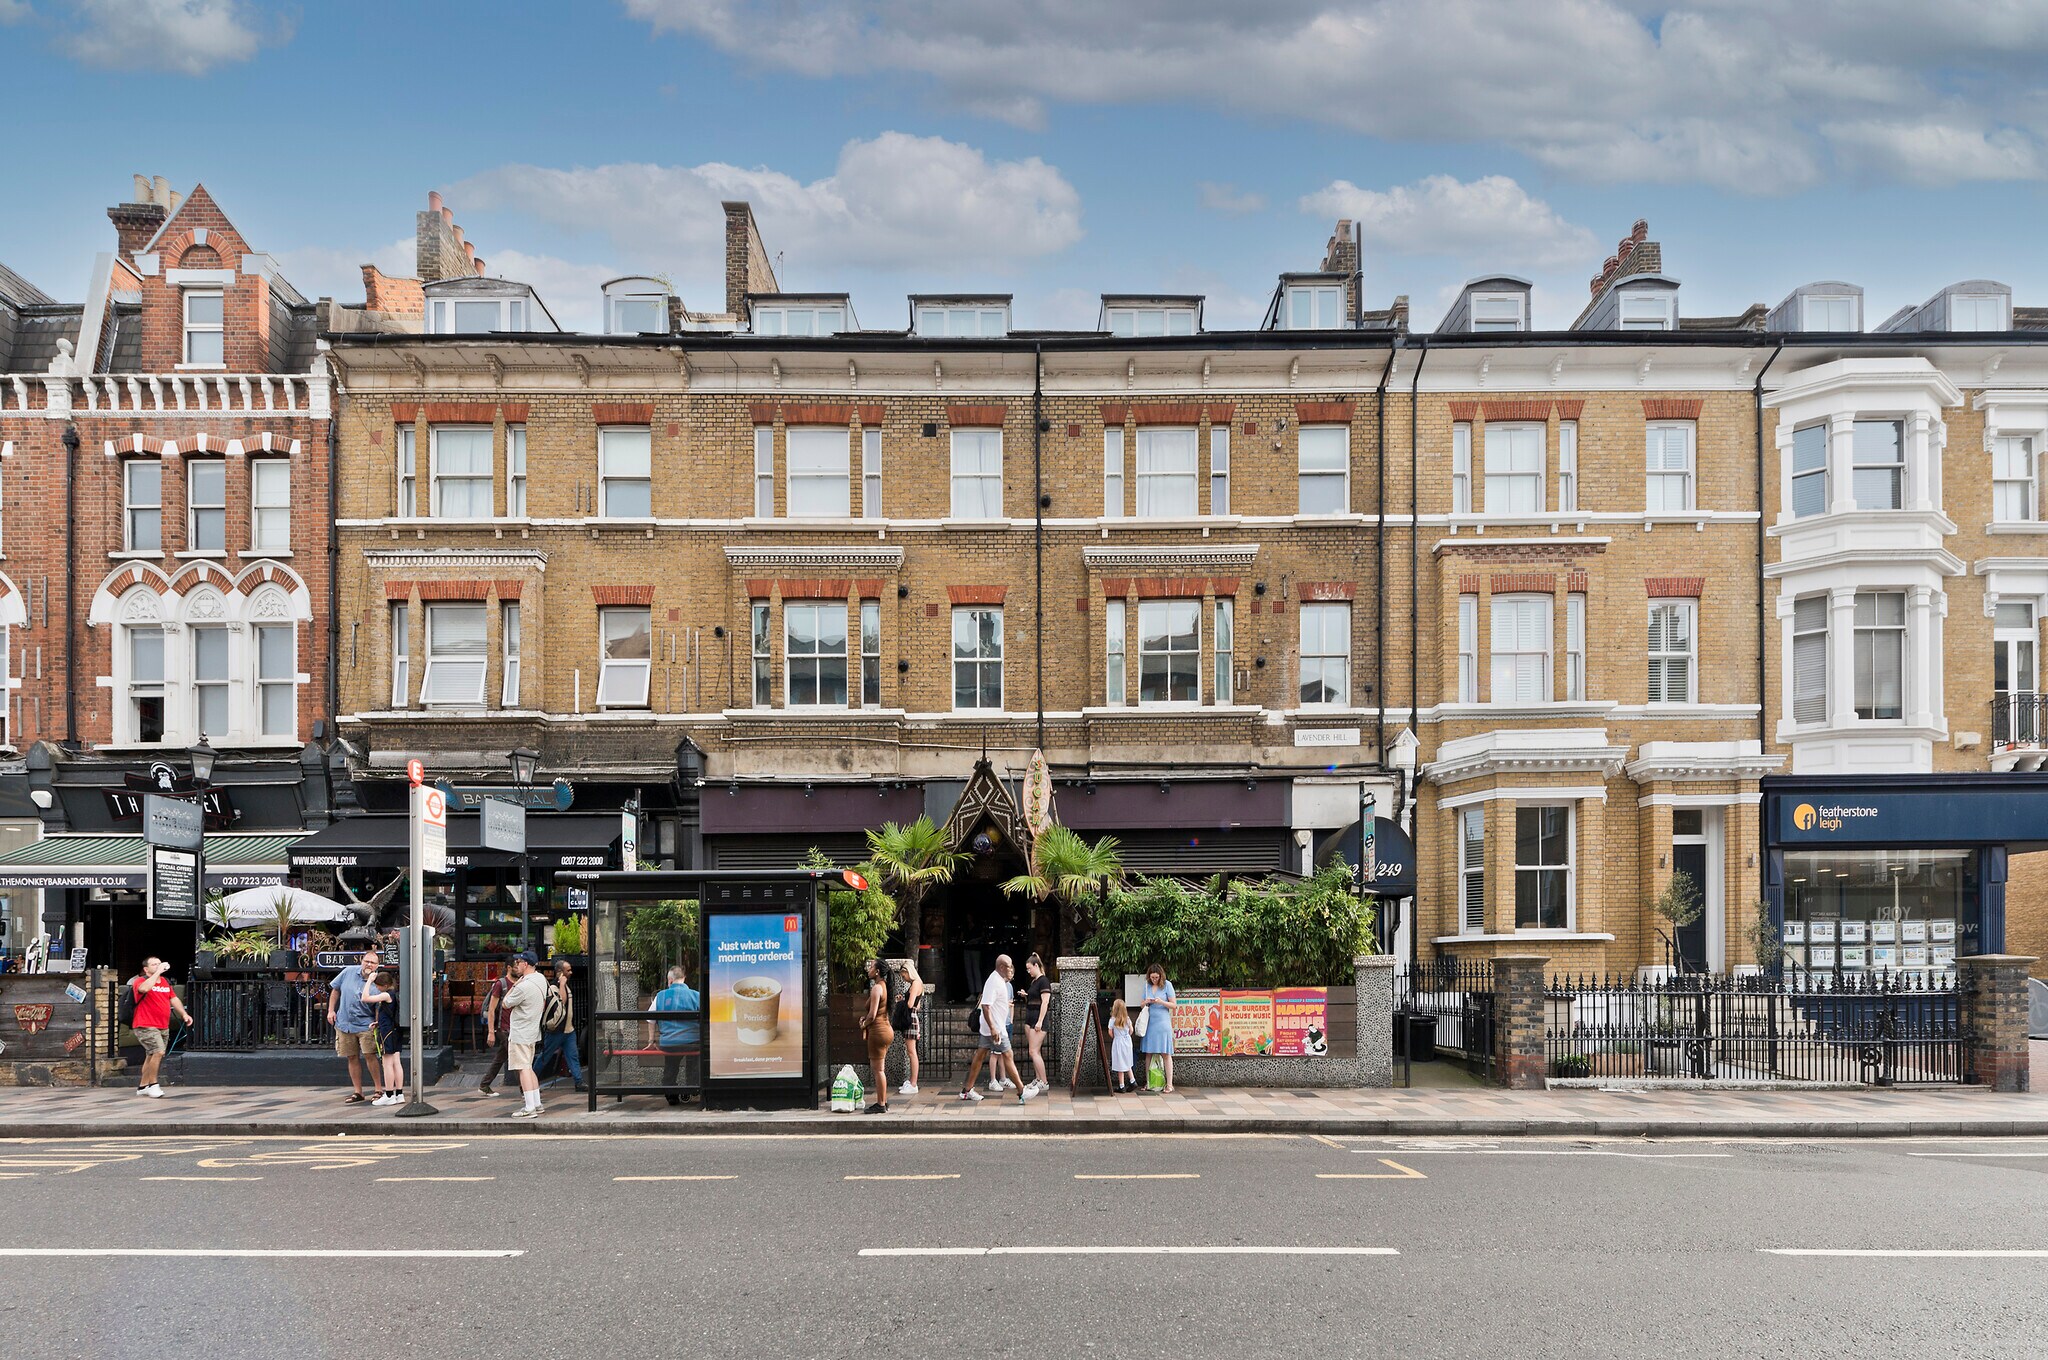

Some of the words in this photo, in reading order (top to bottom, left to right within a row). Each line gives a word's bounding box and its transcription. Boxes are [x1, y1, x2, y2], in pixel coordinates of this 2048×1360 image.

[1297, 734, 1330, 742] LAVENDER
[412, 762, 422, 780] E
[112, 794, 140, 816] TH
[1819, 805, 1878, 817] featherstone
[1820, 817, 1842, 832] leigh
[292, 856, 358, 866] WWW.BARSOCIAL.CO.UK
[456, 856, 468, 865] BAR
[561, 856, 576, 866] 0207
[576, 856, 588, 866] 223
[588, 856, 604, 866] 2000
[222, 877, 238, 885] 020
[240, 877, 260, 885] 7223
[262, 877, 281, 885] 2000
[718, 942, 739, 951] Just
[740, 940, 763, 950] what
[764, 940, 780, 949] the
[326, 955, 344, 964] BAR
[718, 952, 757, 964] morning
[758, 951, 794, 960] ordered
[1172, 1006, 1206, 1016] TAPAS
[1276, 1004, 1325, 1015] HAPPY
[1171, 1017, 1205, 1028] FEAST
[1276, 1016, 1325, 1029] HOUR
[1174, 1027, 1201, 1039] Deals
